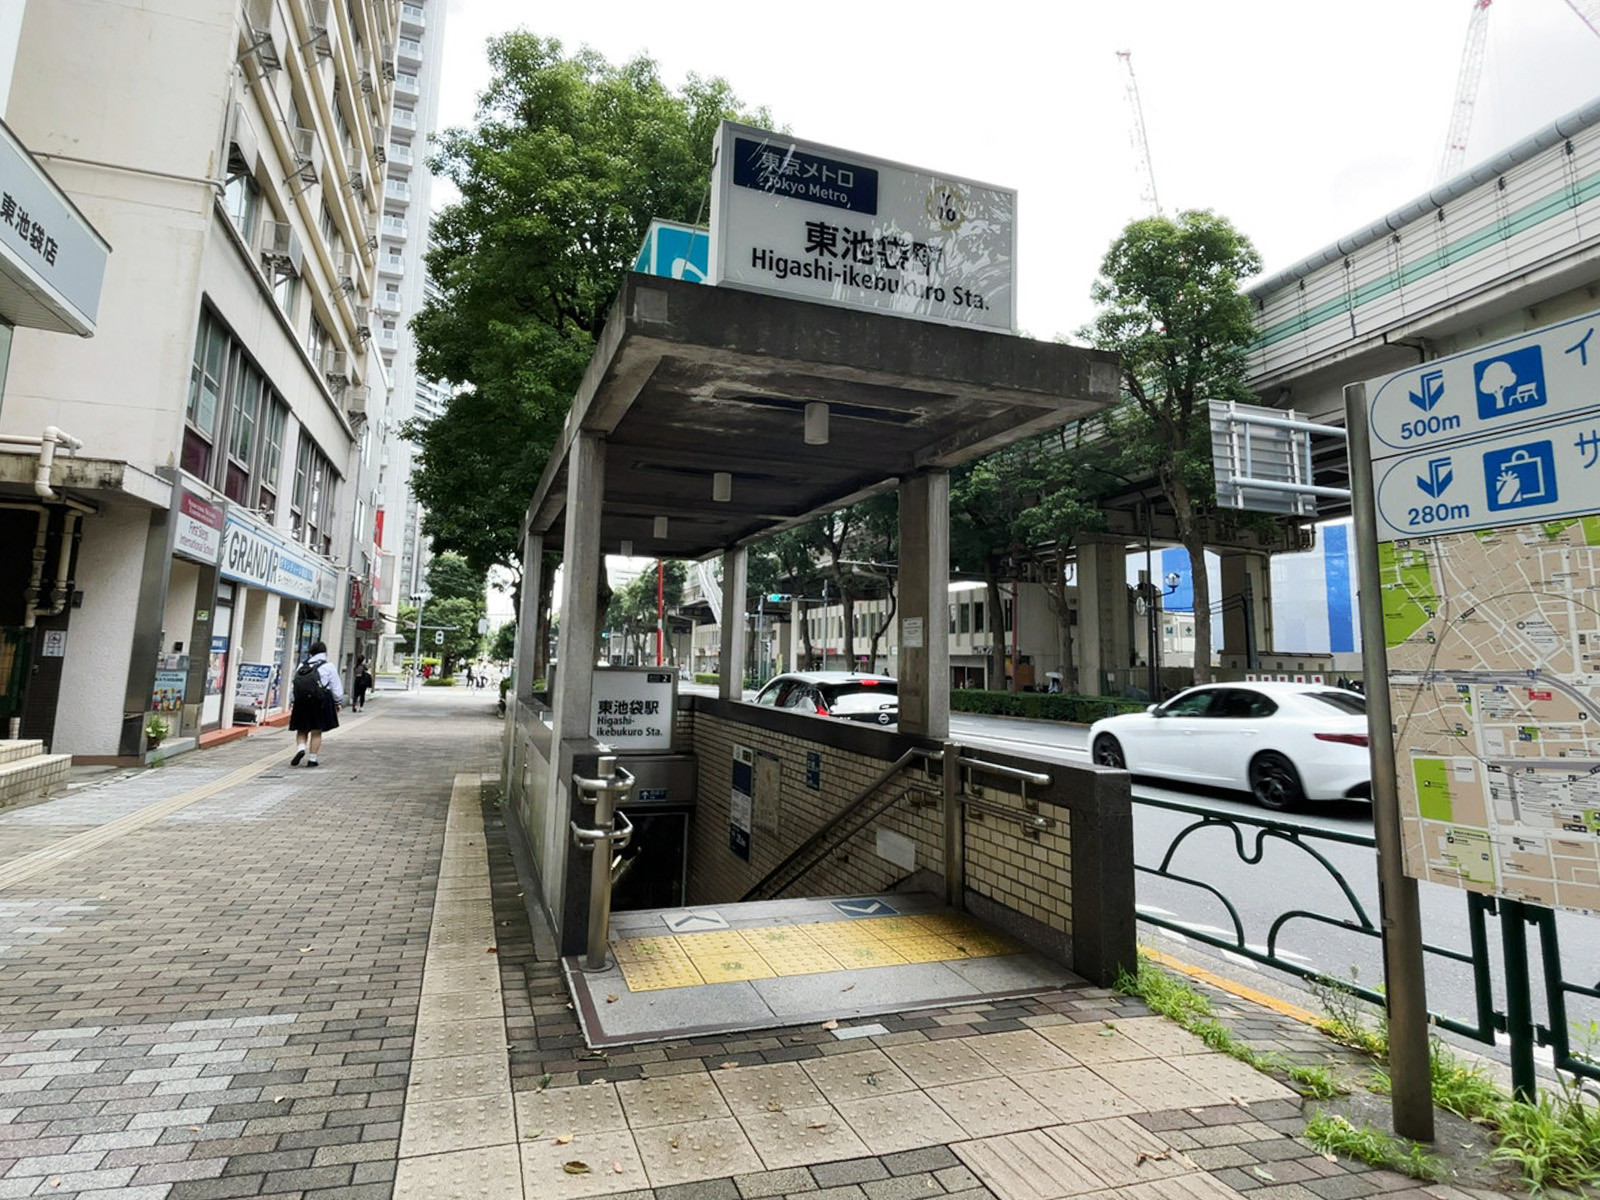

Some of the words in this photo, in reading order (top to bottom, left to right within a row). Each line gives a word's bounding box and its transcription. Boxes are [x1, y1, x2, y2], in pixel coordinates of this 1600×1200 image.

[760, 151, 854, 188] 東京メトロ
[766, 173, 806, 196] Tokyo
[808, 183, 848, 203] Metro
[0, 191, 58, 267] 東池袋店
[751, 247, 945, 303] Higashi-ikebukuro
[953, 286, 990, 311] Sta.
[1565, 328, 1595, 366] イ
[1401, 414, 1461, 440] 500m
[1408, 503, 1470, 526] 280m
[597, 700, 659, 715] 東池袋駅
[597, 716, 634, 727] Higashi-
[597, 727, 643, 737] ikebukuro
[646, 727, 663, 737] Sta.
